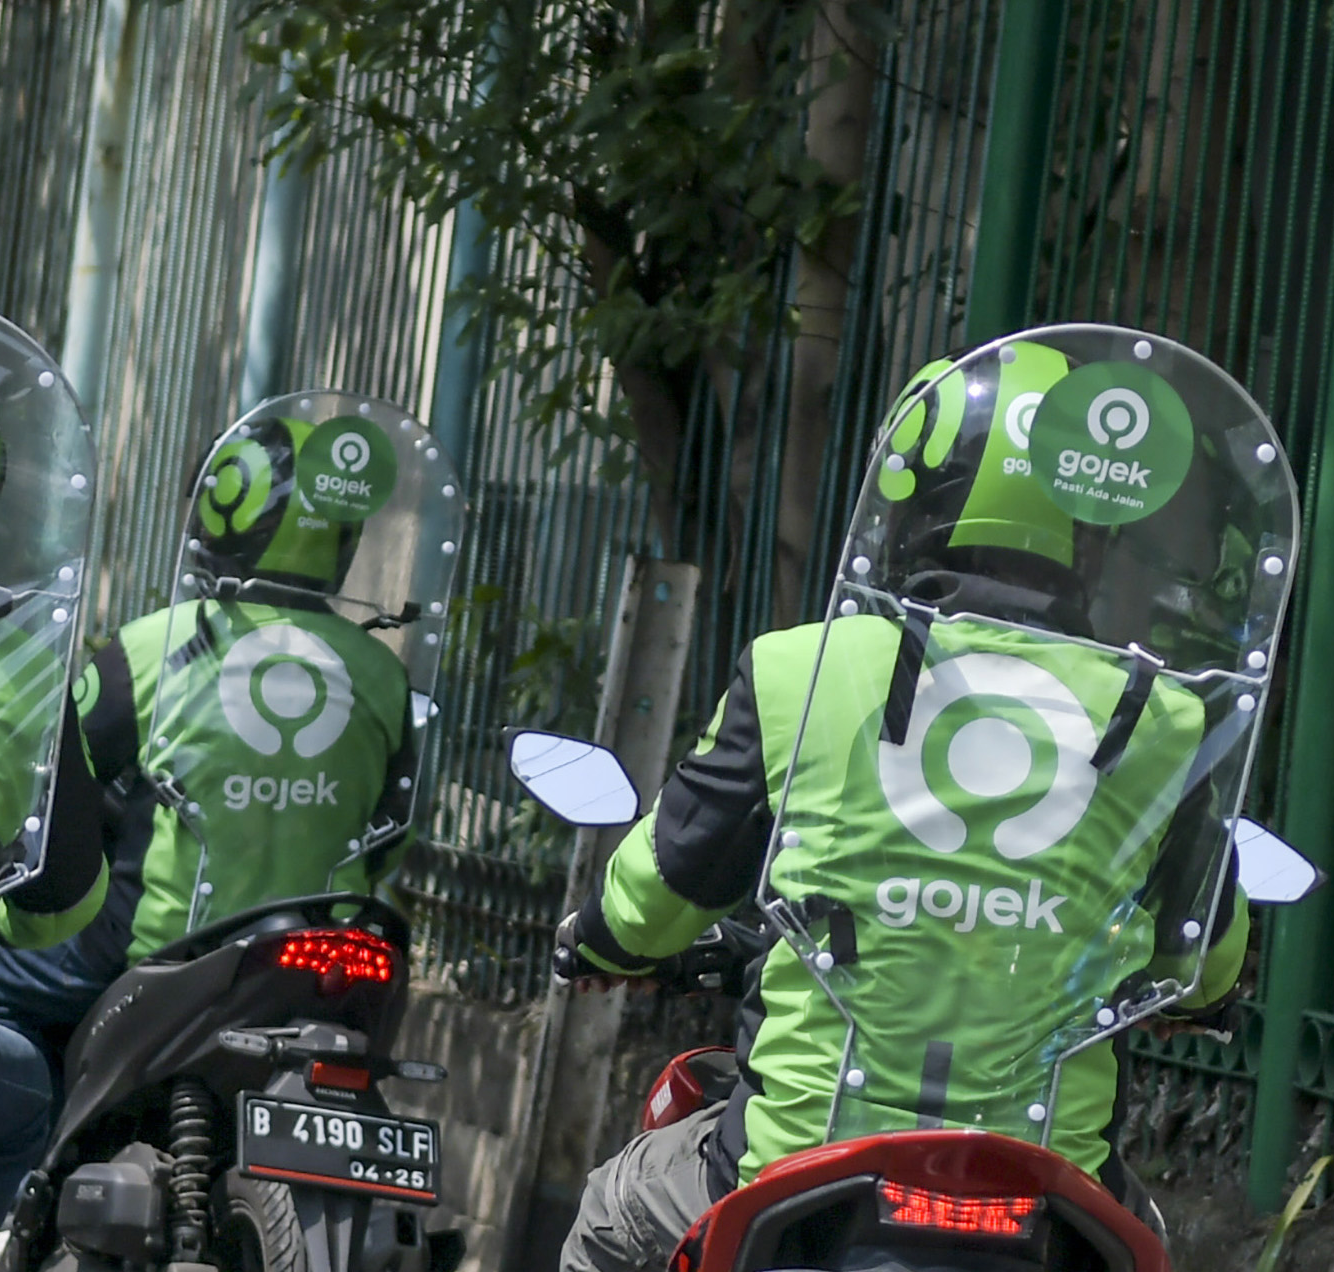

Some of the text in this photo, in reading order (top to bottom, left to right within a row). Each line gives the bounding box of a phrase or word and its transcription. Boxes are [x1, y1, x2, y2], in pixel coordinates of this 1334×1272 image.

[1003, 457, 1032, 476] goj
[1057, 449, 1151, 488] gojek
[315, 473, 372, 497] gojek
[1053, 478, 1144, 509] Pasti Ada Jalan
[223, 772, 339, 811] gojek
[877, 876, 1067, 933] gojek
[316, 1087, 357, 1100] HONDA
[253, 1106, 429, 1160] B 4190 SLF
